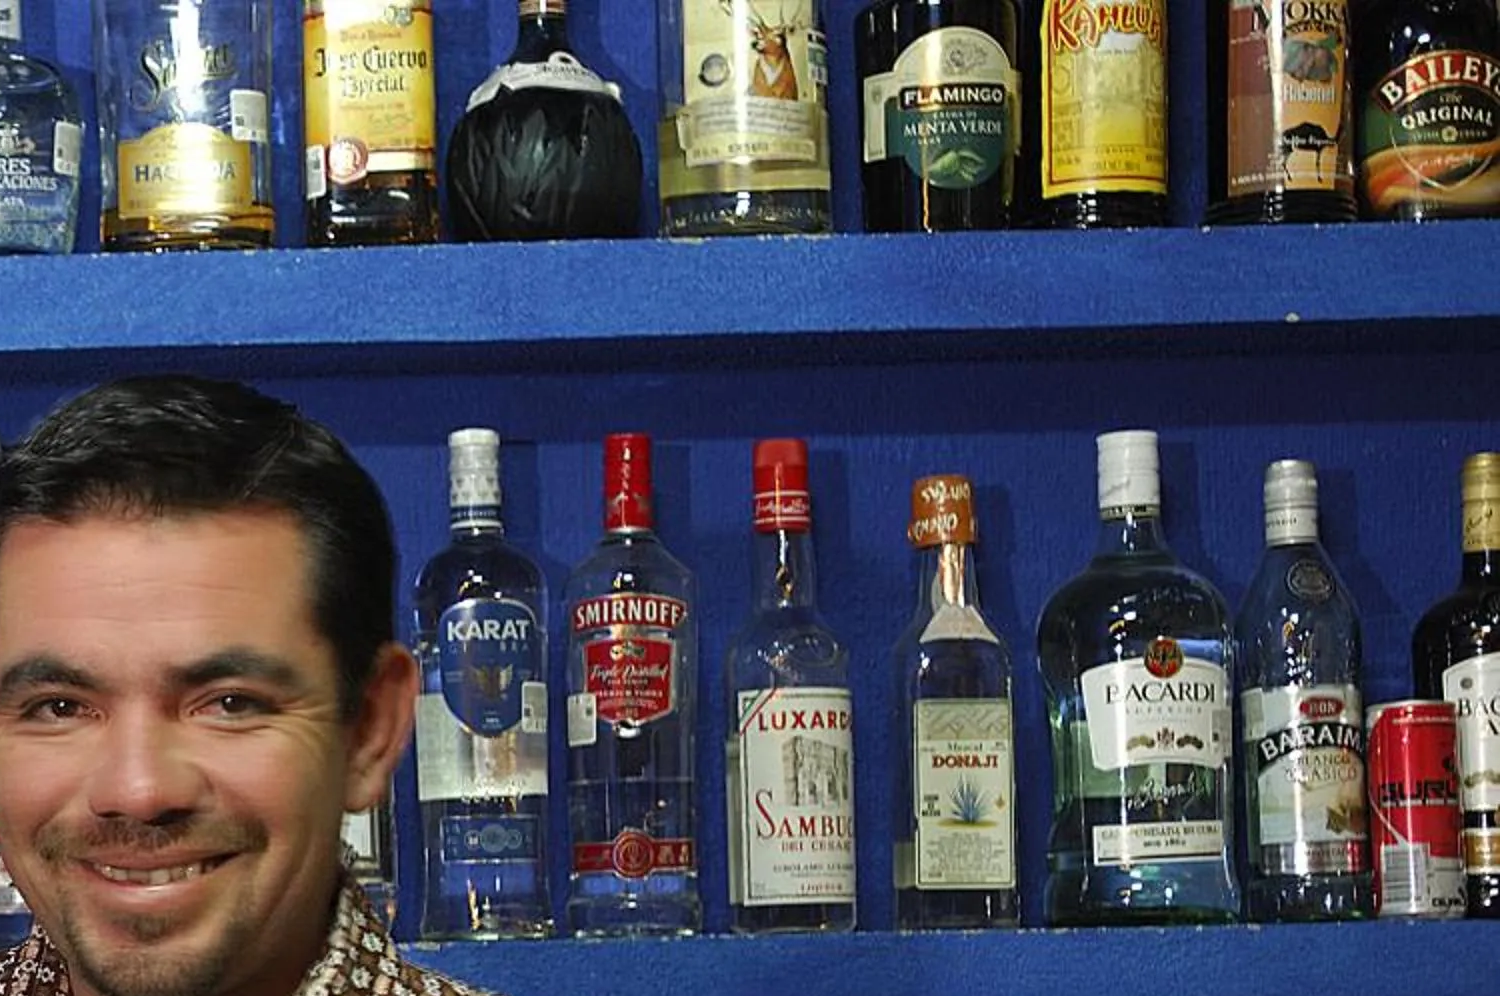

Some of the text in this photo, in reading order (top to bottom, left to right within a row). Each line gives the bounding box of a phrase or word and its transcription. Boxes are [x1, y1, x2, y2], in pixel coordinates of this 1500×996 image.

[363, 45, 427, 73] Cuervo
[904, 87, 1002, 105] FLAMINGO
[903, 121, 957, 136] MENTA
[1401, 105, 1493, 130] ORIGINAL
[577, 598, 681, 629] SMIRNOFF
[447, 619, 531, 641] KARAT
[1106, 680, 1216, 706] BACARDI
[758, 707, 853, 732] LUXARD
[1260, 724, 1363, 761] BARAIM
[932, 755, 999, 769] DONAJI
